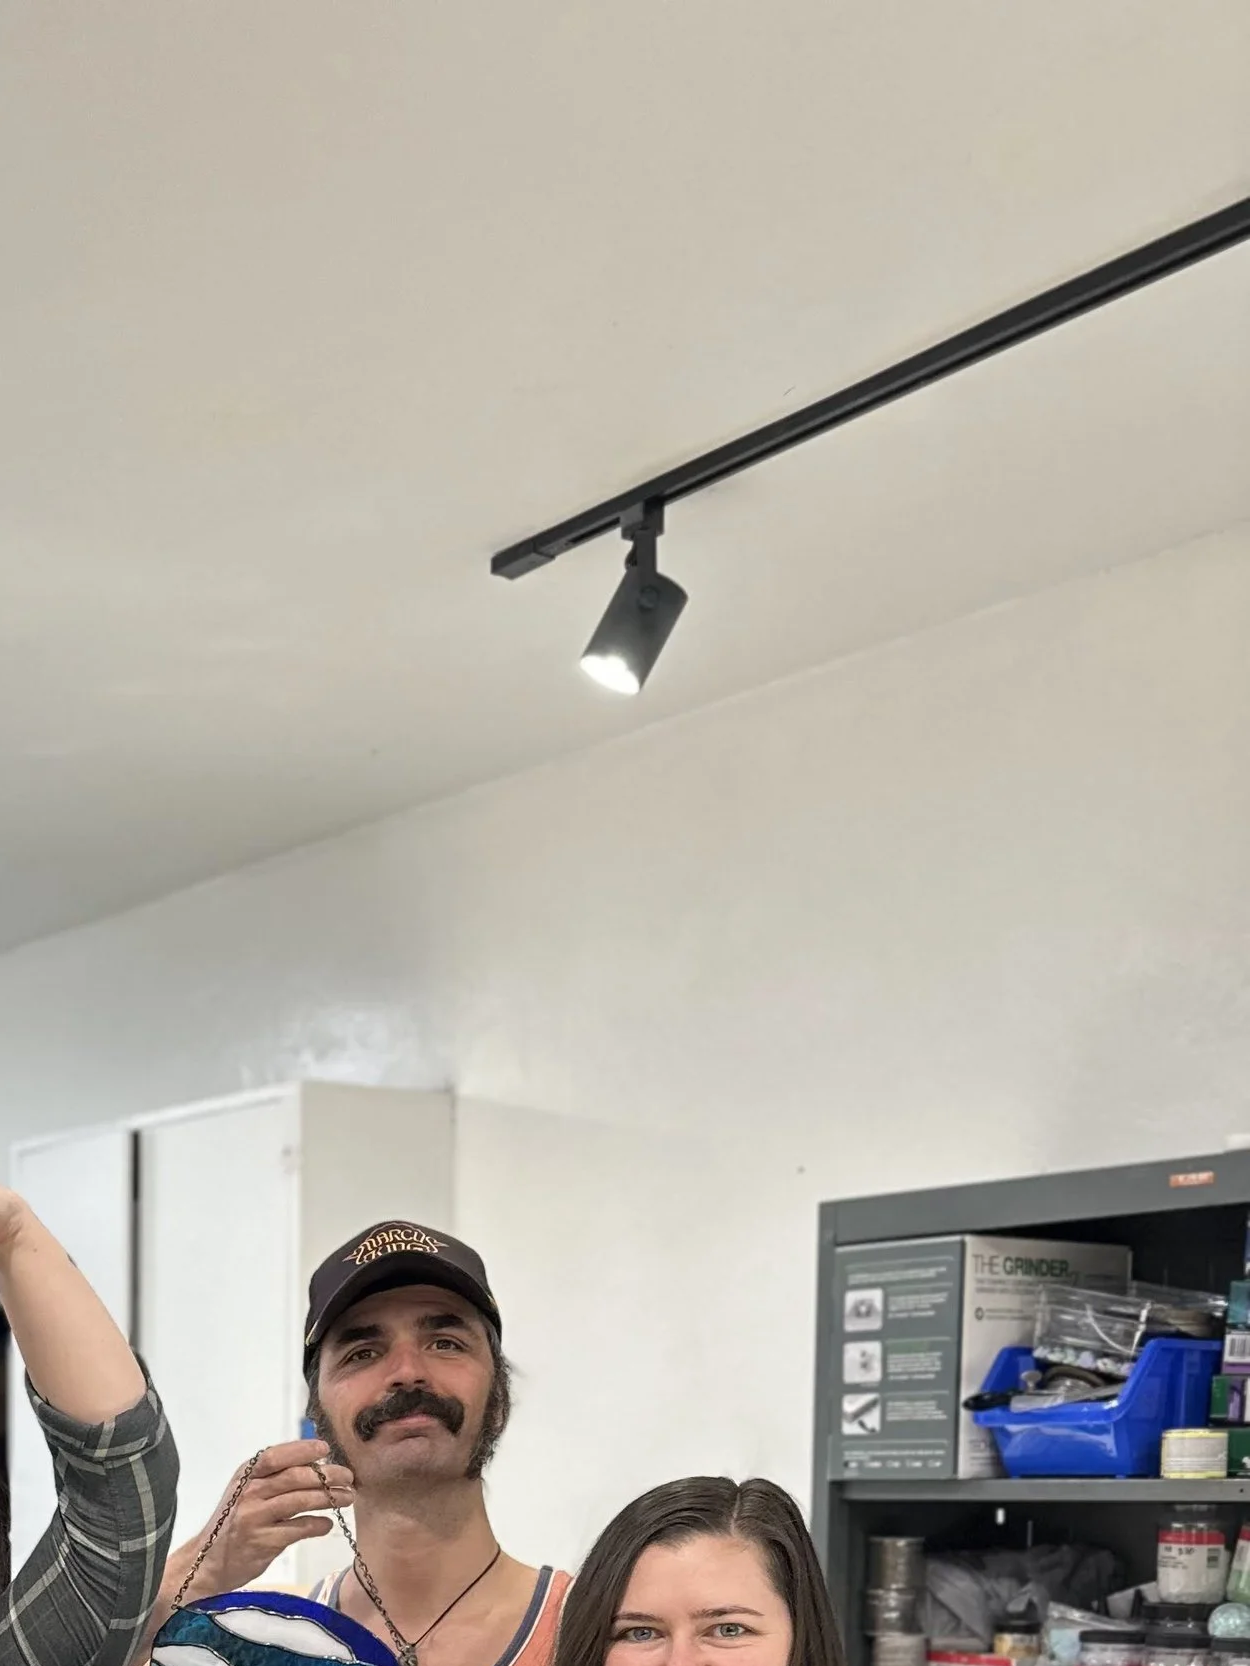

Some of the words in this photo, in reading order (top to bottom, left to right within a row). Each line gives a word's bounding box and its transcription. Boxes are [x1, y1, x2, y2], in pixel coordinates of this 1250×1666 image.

[356, 1228, 438, 1259] MARCUS
[972, 1253, 999, 1275] THE
[1002, 1255, 1070, 1278] GRINDER
